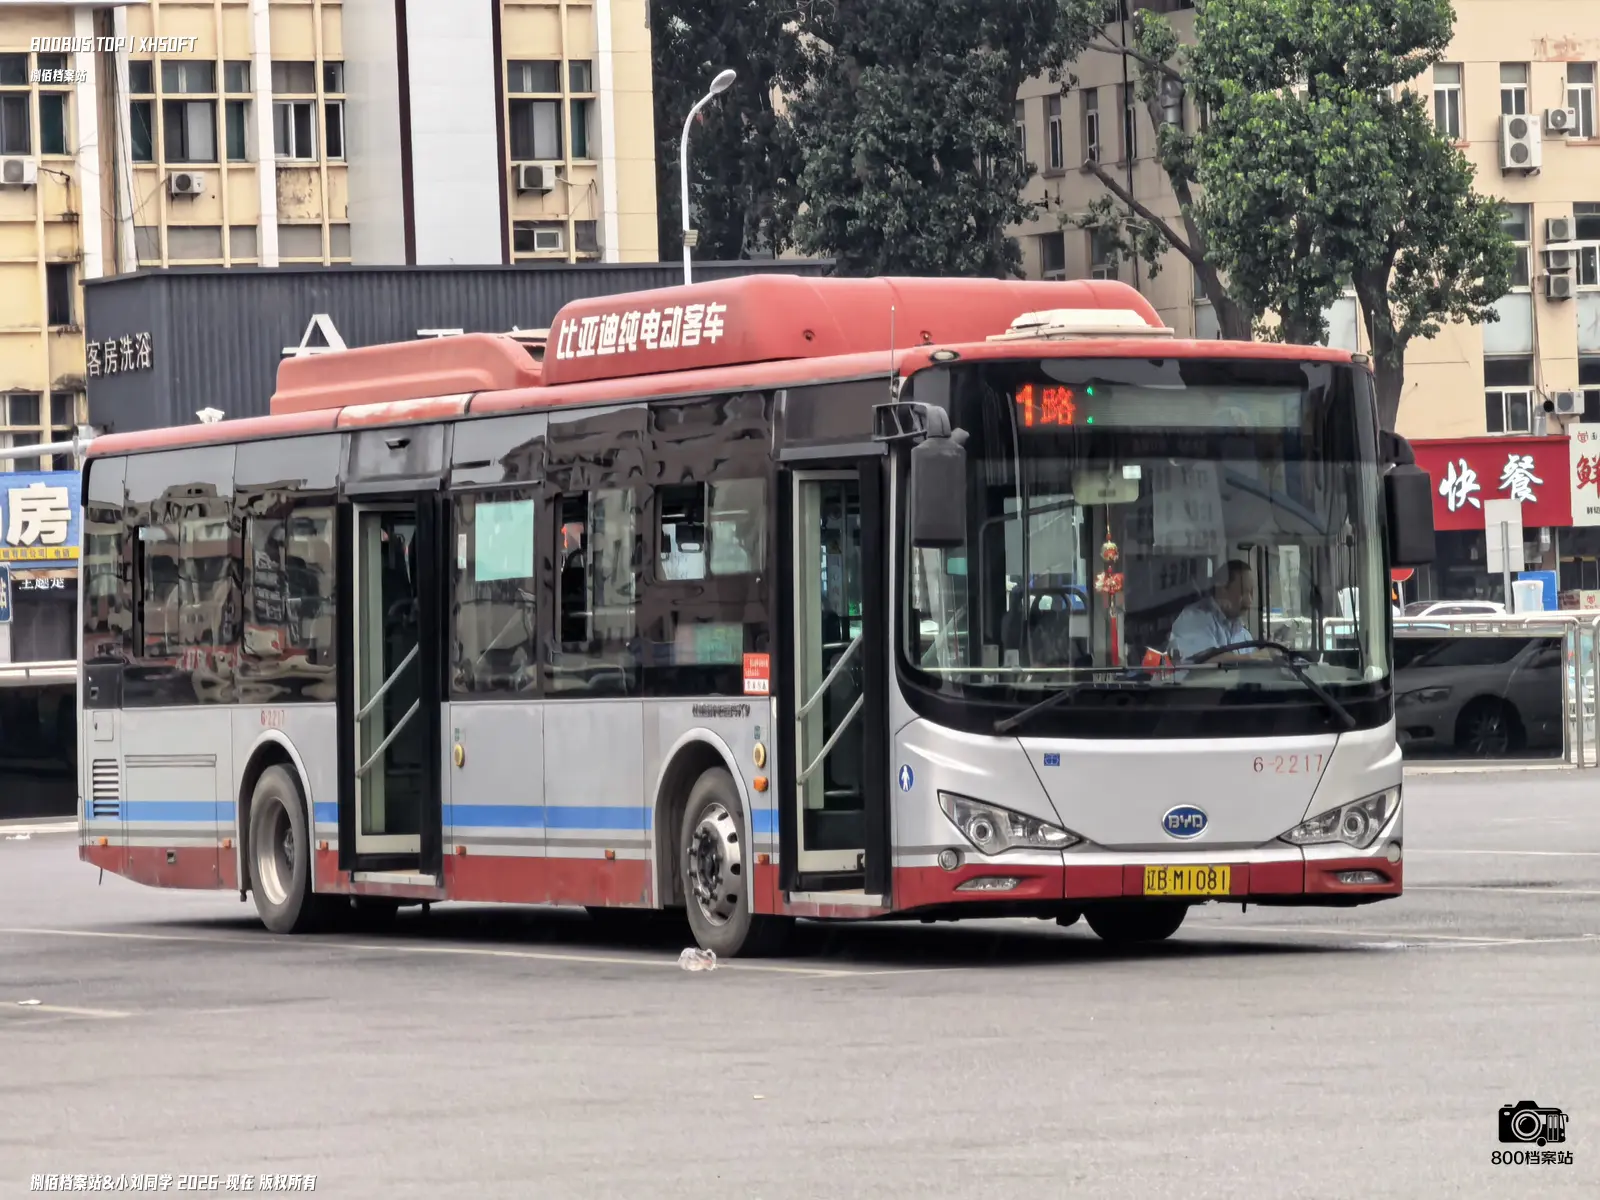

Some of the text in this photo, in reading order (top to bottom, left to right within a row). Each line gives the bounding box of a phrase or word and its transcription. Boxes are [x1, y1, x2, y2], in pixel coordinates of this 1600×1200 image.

[556, 301, 728, 360] 比亚迪纯电动客车
[86, 331, 152, 378] 客房洗浴
[1015, 384, 1077, 427] 1路
[1438, 453, 1544, 513] 快餐
[6, 481, 72, 547] 房
[1253, 753, 1324, 774] 6-2217
[1168, 814, 1204, 830] BYD
